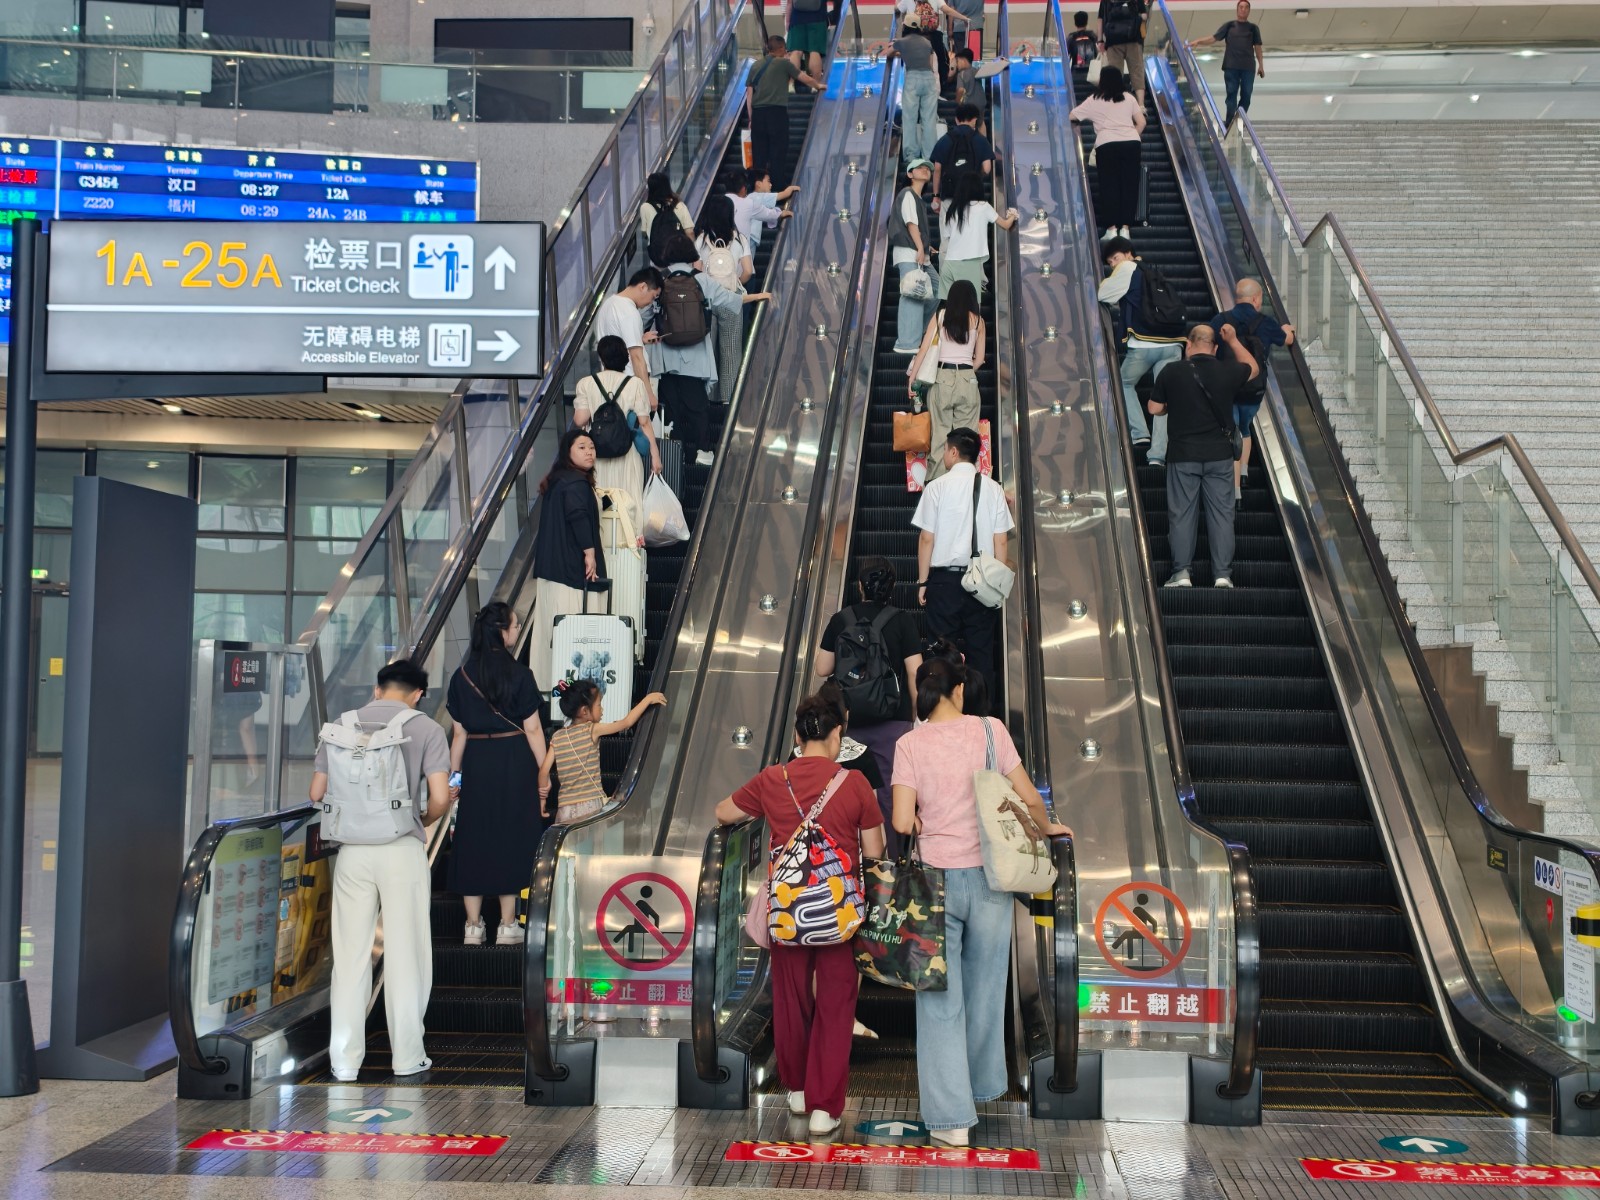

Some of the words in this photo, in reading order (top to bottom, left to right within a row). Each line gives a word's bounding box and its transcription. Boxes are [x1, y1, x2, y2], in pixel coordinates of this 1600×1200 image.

[95, 162, 125, 172] Number
[275, 170, 294, 180] Time
[344, 174, 367, 184] Check
[79, 175, 119, 189] G3454
[168, 177, 196, 192] 汉口
[240, 183, 279, 197] 08:27
[326, 187, 349, 200] 12A
[414, 190, 444, 205] 候车
[83, 197, 114, 209] Z220
[167, 198, 196, 214] 福州
[240, 204, 279, 217] 08:29
[304, 237, 402, 271] 检票口
[290, 275, 342, 293] Ticket
[344, 277, 400, 293] Check
[302, 325, 421, 348] 无障碍电梯
[301, 351, 367, 363] Accessible
[369, 351, 420, 364] Elevator
[1089, 991, 1199, 1017] 禁止翻越
[302, 1136, 479, 1150] 禁止停留
[834, 1149, 1010, 1163] 禁止停留
[1414, 1166, 1600, 1181] 禁止停留
